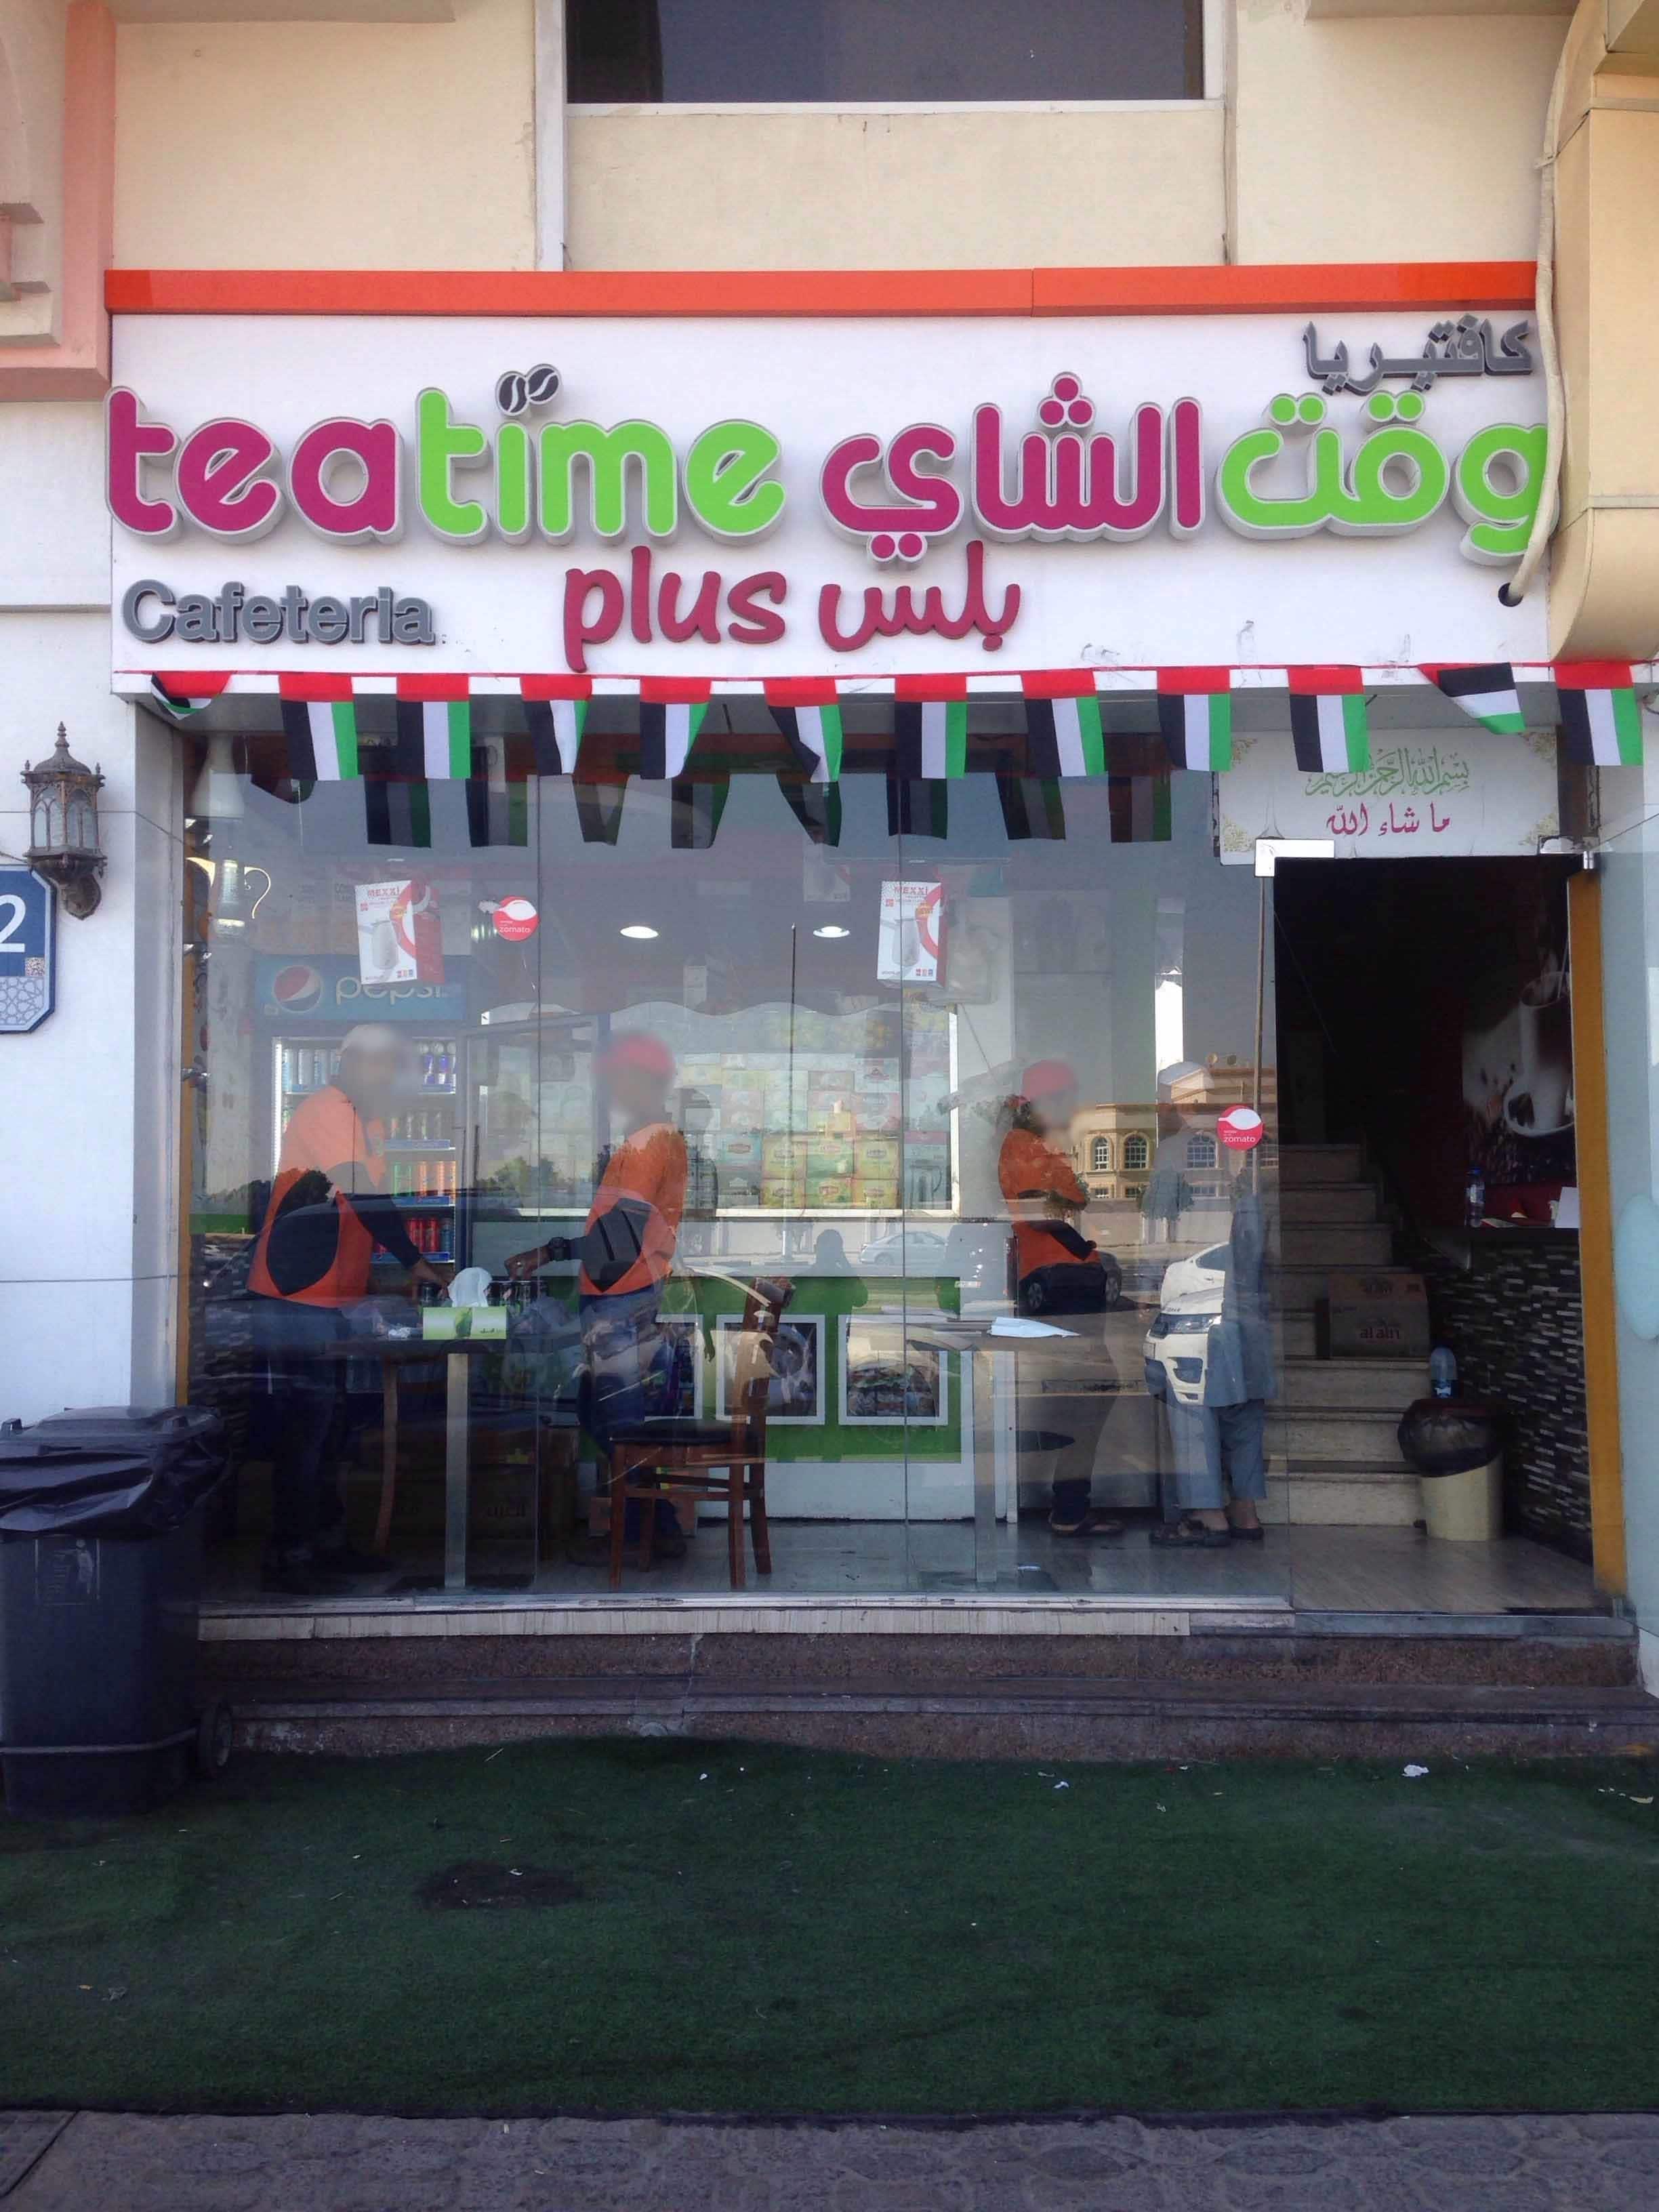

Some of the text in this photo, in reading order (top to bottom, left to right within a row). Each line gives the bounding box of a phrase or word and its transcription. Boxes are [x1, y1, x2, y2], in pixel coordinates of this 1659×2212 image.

[1302, 313, 1532, 396] كافتيريا
[819, 371, 1557, 568] وقت الشاي
[121, 578, 436, 644] Cafeteria
[564, 545, 787, 673] plus
[818, 540, 1021, 652] بلس
[1431, 802, 1450, 832] ما
[499, 926, 531, 934] zomato
[1224, 1135, 1256, 1143] zomato
